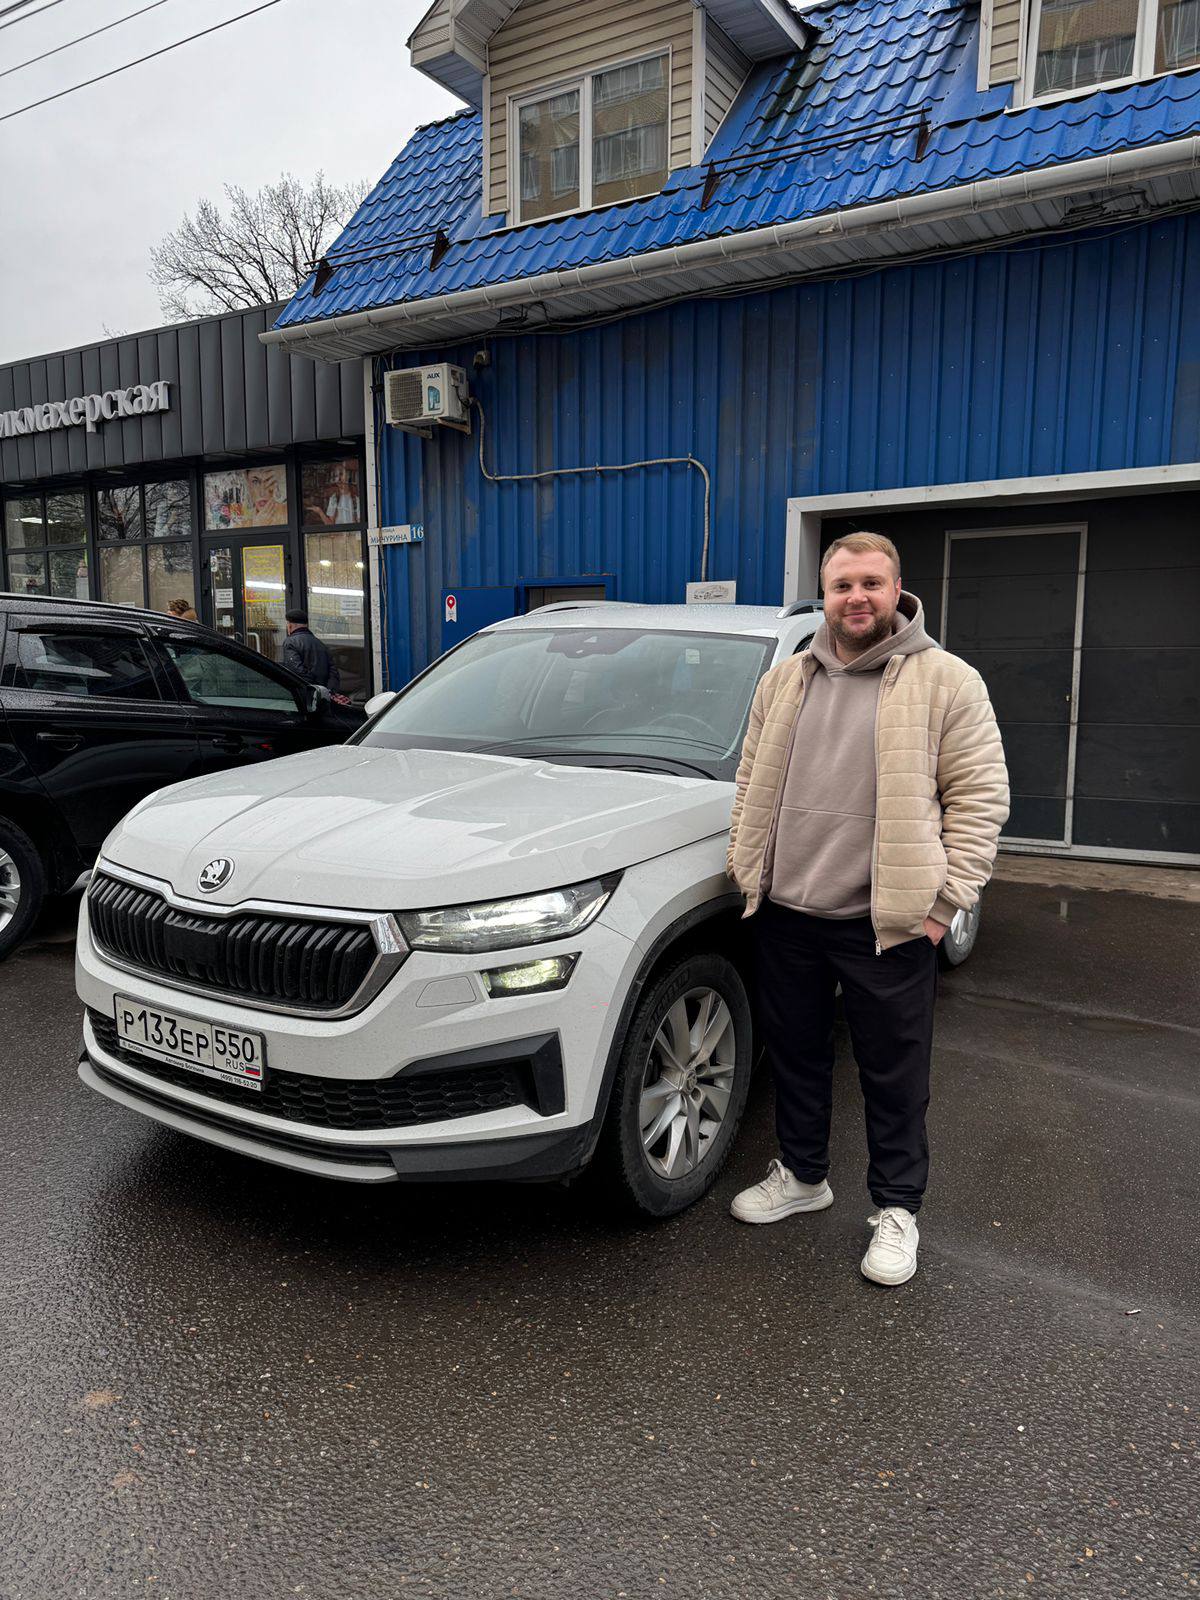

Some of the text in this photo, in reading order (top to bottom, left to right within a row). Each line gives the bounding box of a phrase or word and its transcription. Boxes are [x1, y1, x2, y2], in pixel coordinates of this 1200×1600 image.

[411, 526, 424, 539] 16
[123, 1010, 255, 1062] Р133ЕР 550
[225, 1058, 245, 1071] RUS
